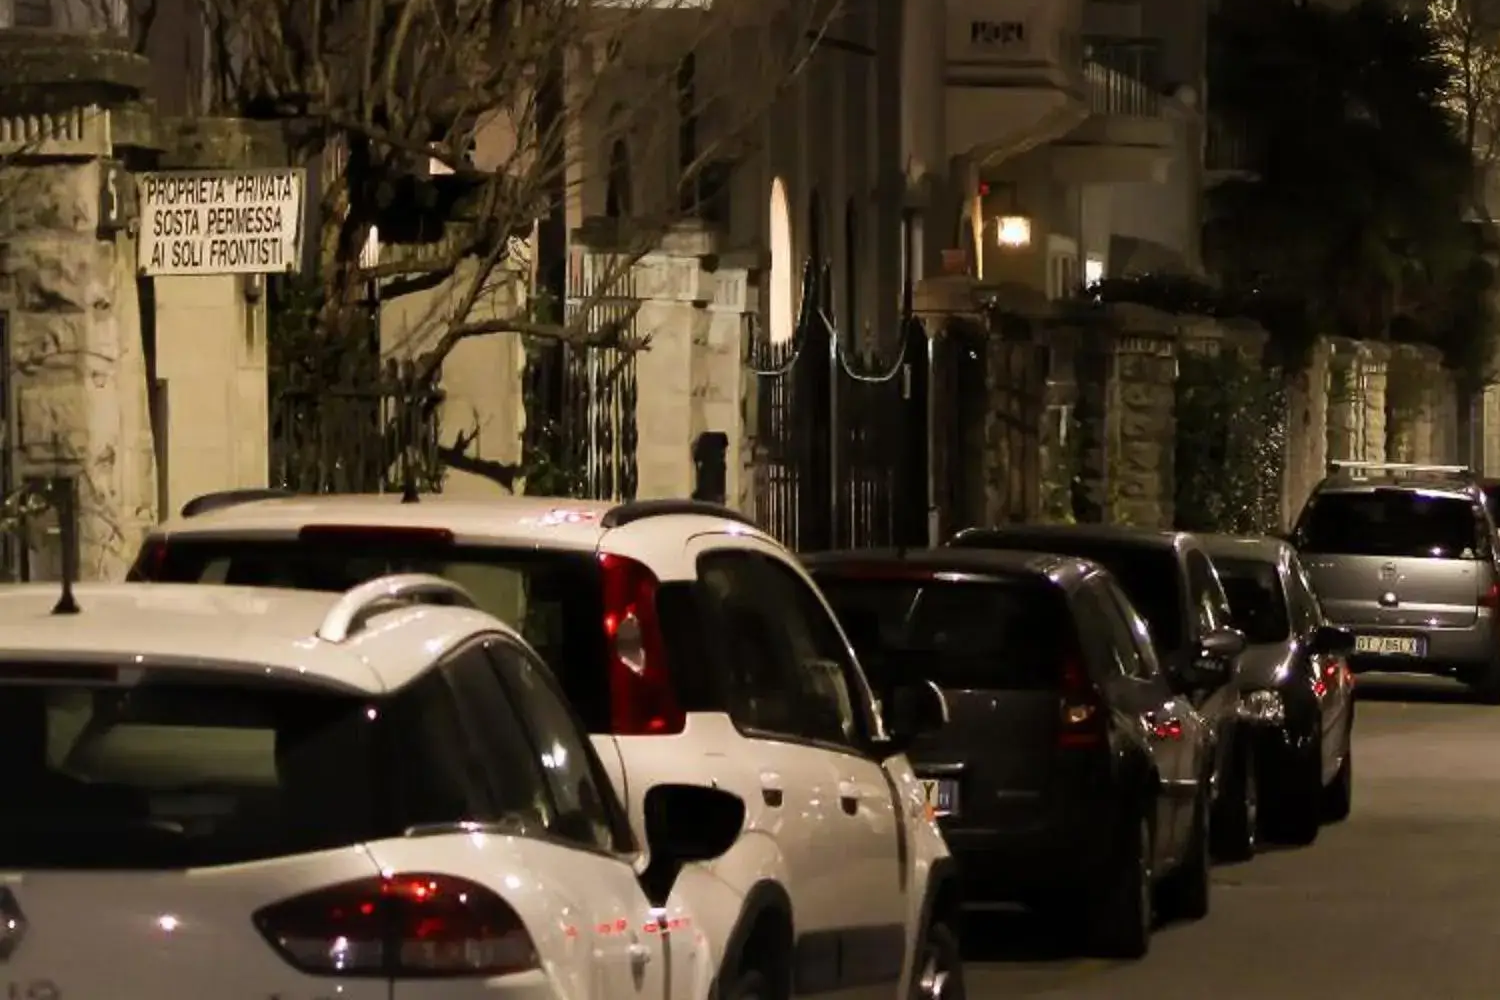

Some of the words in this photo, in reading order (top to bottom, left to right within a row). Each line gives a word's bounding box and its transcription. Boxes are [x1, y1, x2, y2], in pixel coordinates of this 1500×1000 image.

[235, 174, 292, 202] PRIVATA
[153, 208, 199, 237] SOSTA
[206, 206, 283, 237] PERMESSA
[151, 240, 166, 268] AI
[171, 239, 203, 267] SOLI
[209, 238, 284, 267] FRONTISTI
